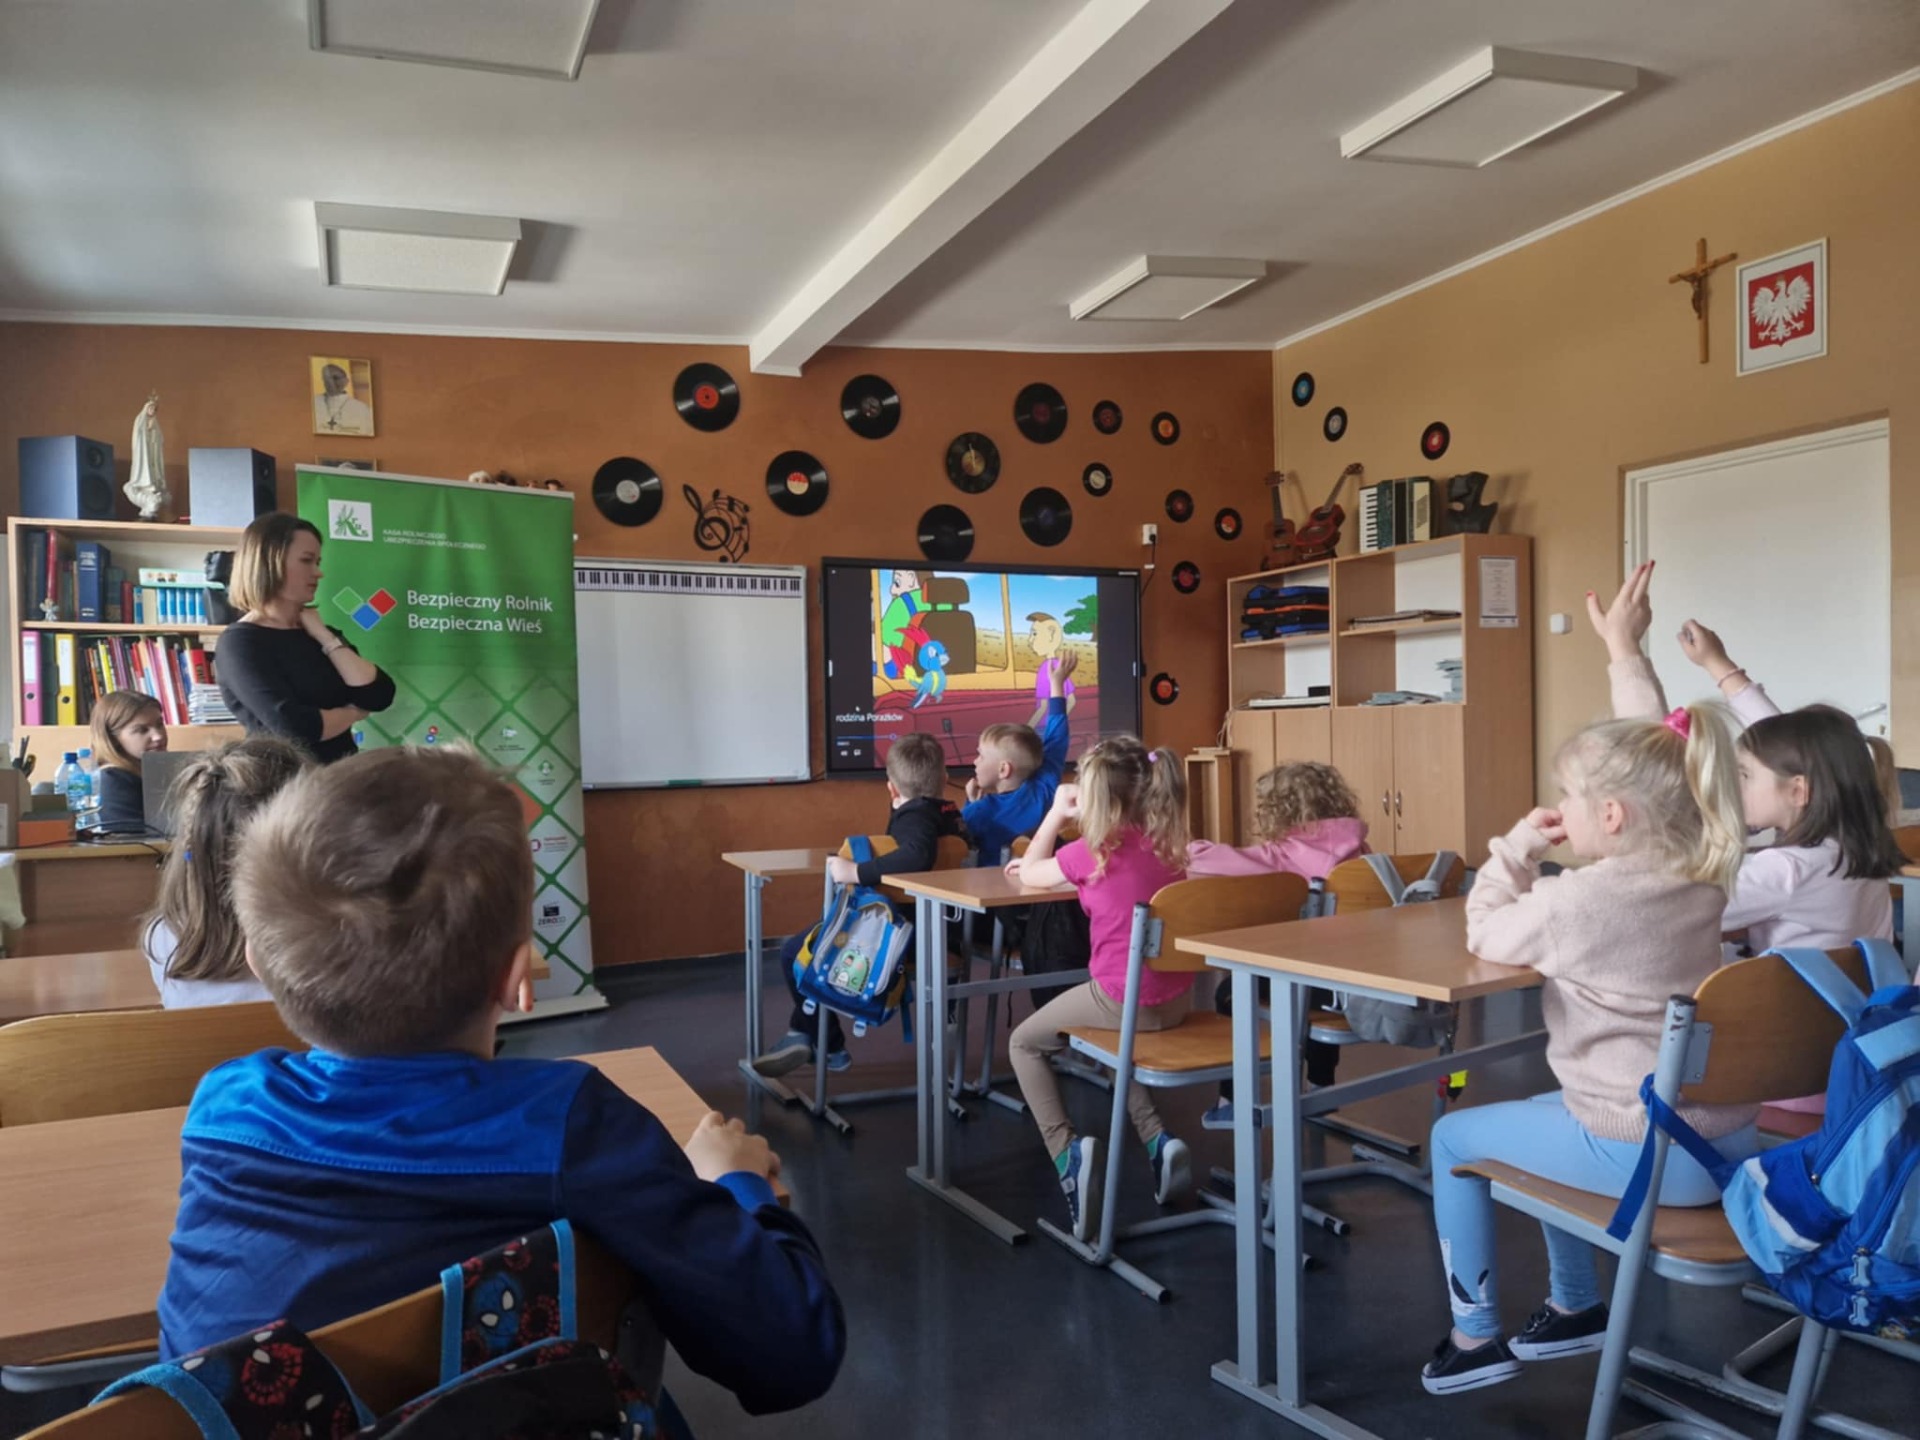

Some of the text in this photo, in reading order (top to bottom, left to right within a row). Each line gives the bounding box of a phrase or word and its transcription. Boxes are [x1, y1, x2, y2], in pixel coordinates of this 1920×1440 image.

[407, 590, 553, 612] Bezpieczny Rolnik
[408, 613, 542, 633] Bezpieczna Wieś
[835, 713, 866, 722] rodzina
